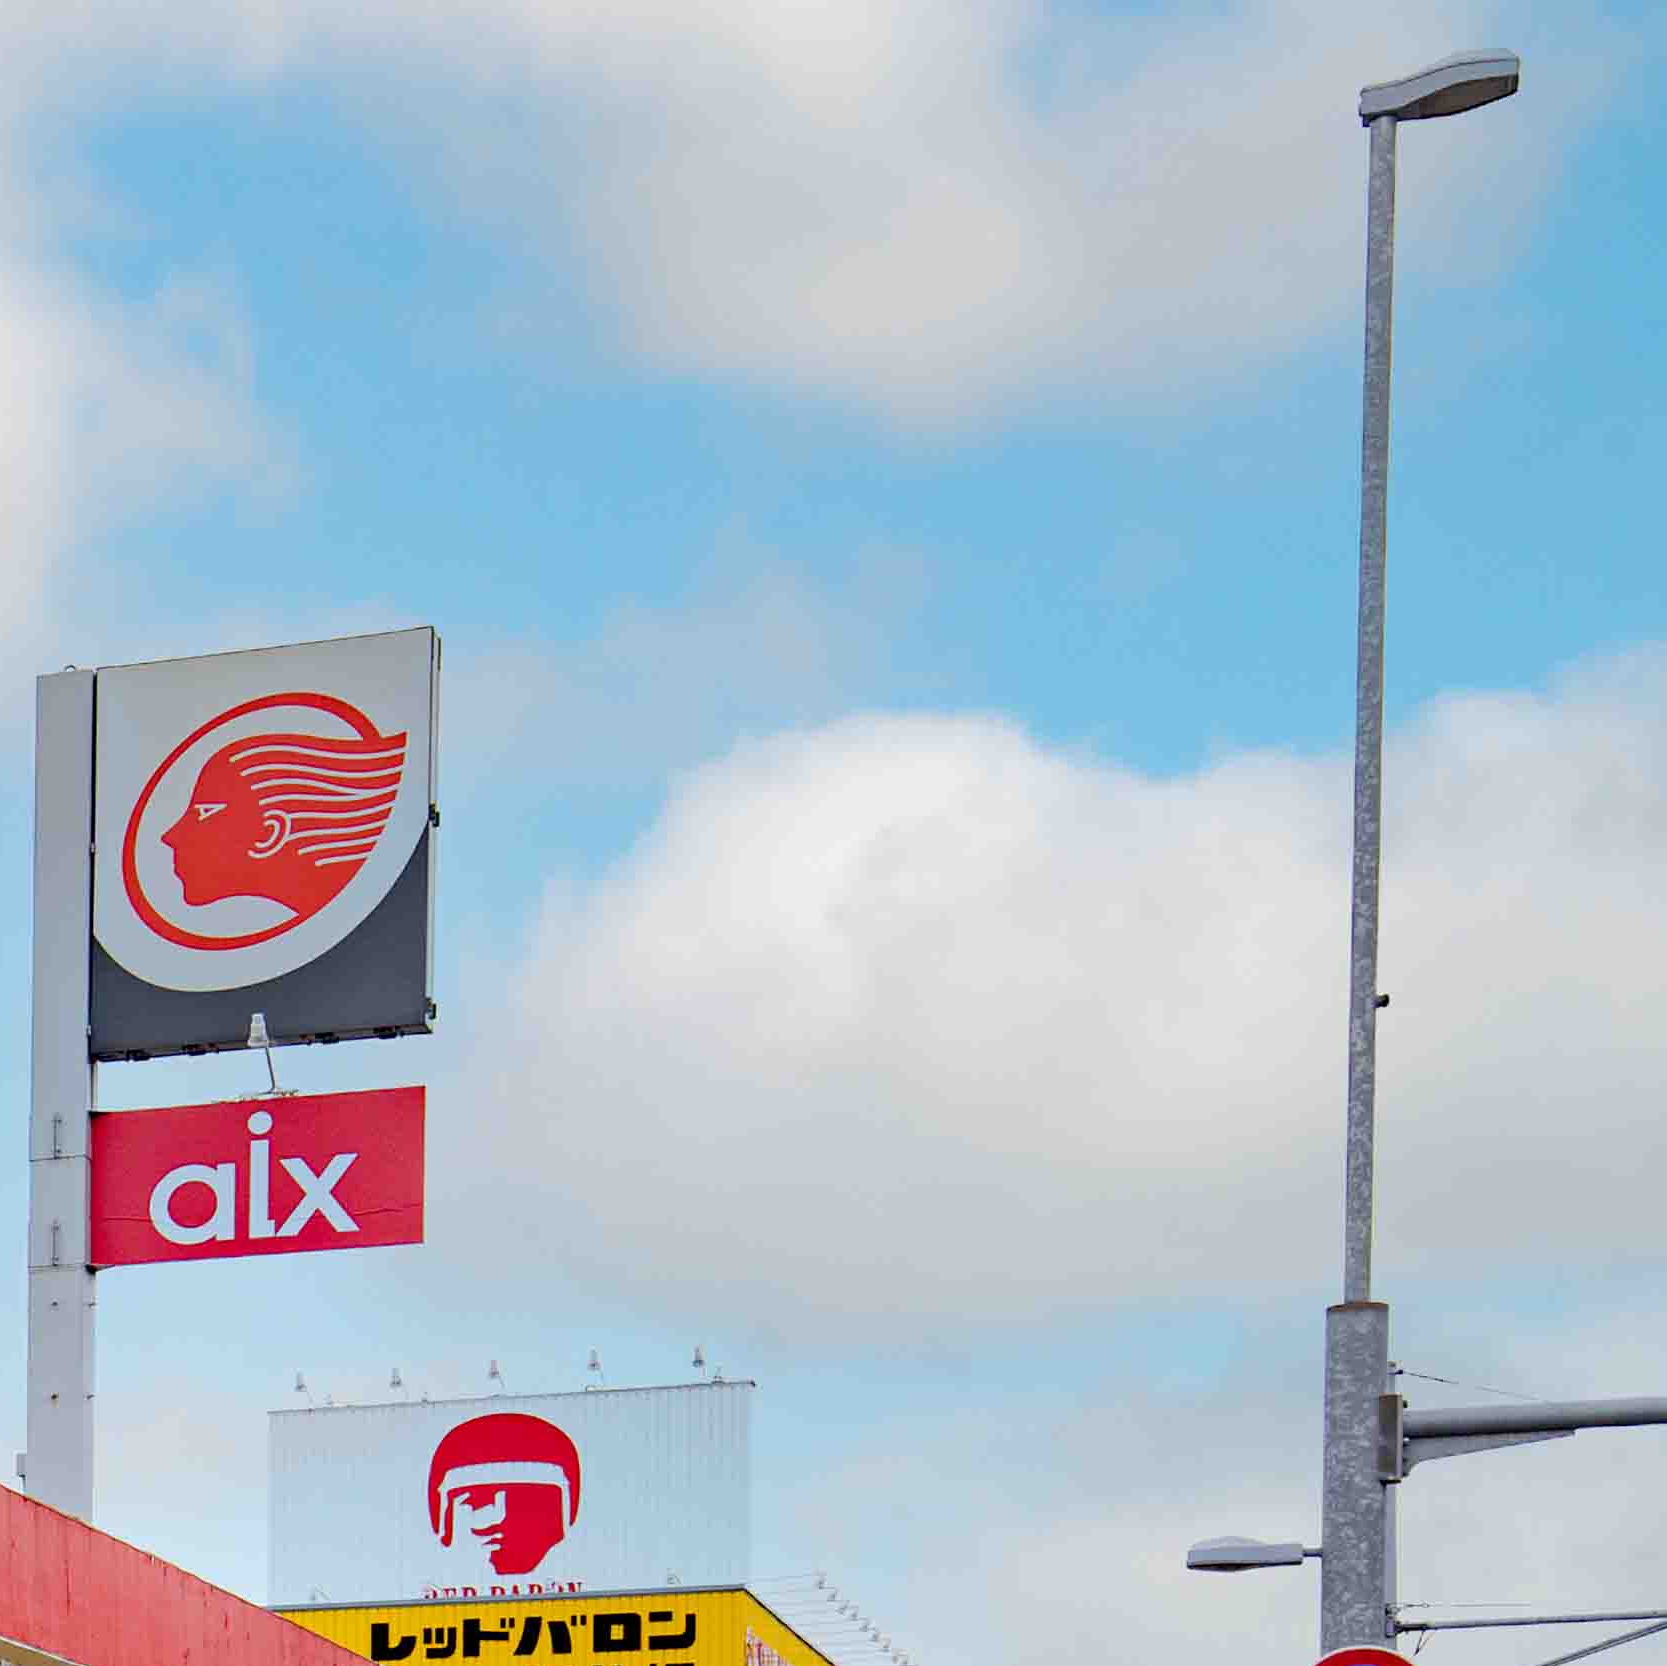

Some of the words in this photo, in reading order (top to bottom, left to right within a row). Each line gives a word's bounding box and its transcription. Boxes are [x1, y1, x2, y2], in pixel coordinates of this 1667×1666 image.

[149, 1110, 360, 1245] aix
[370, 1610, 697, 1662] レッドバロン
